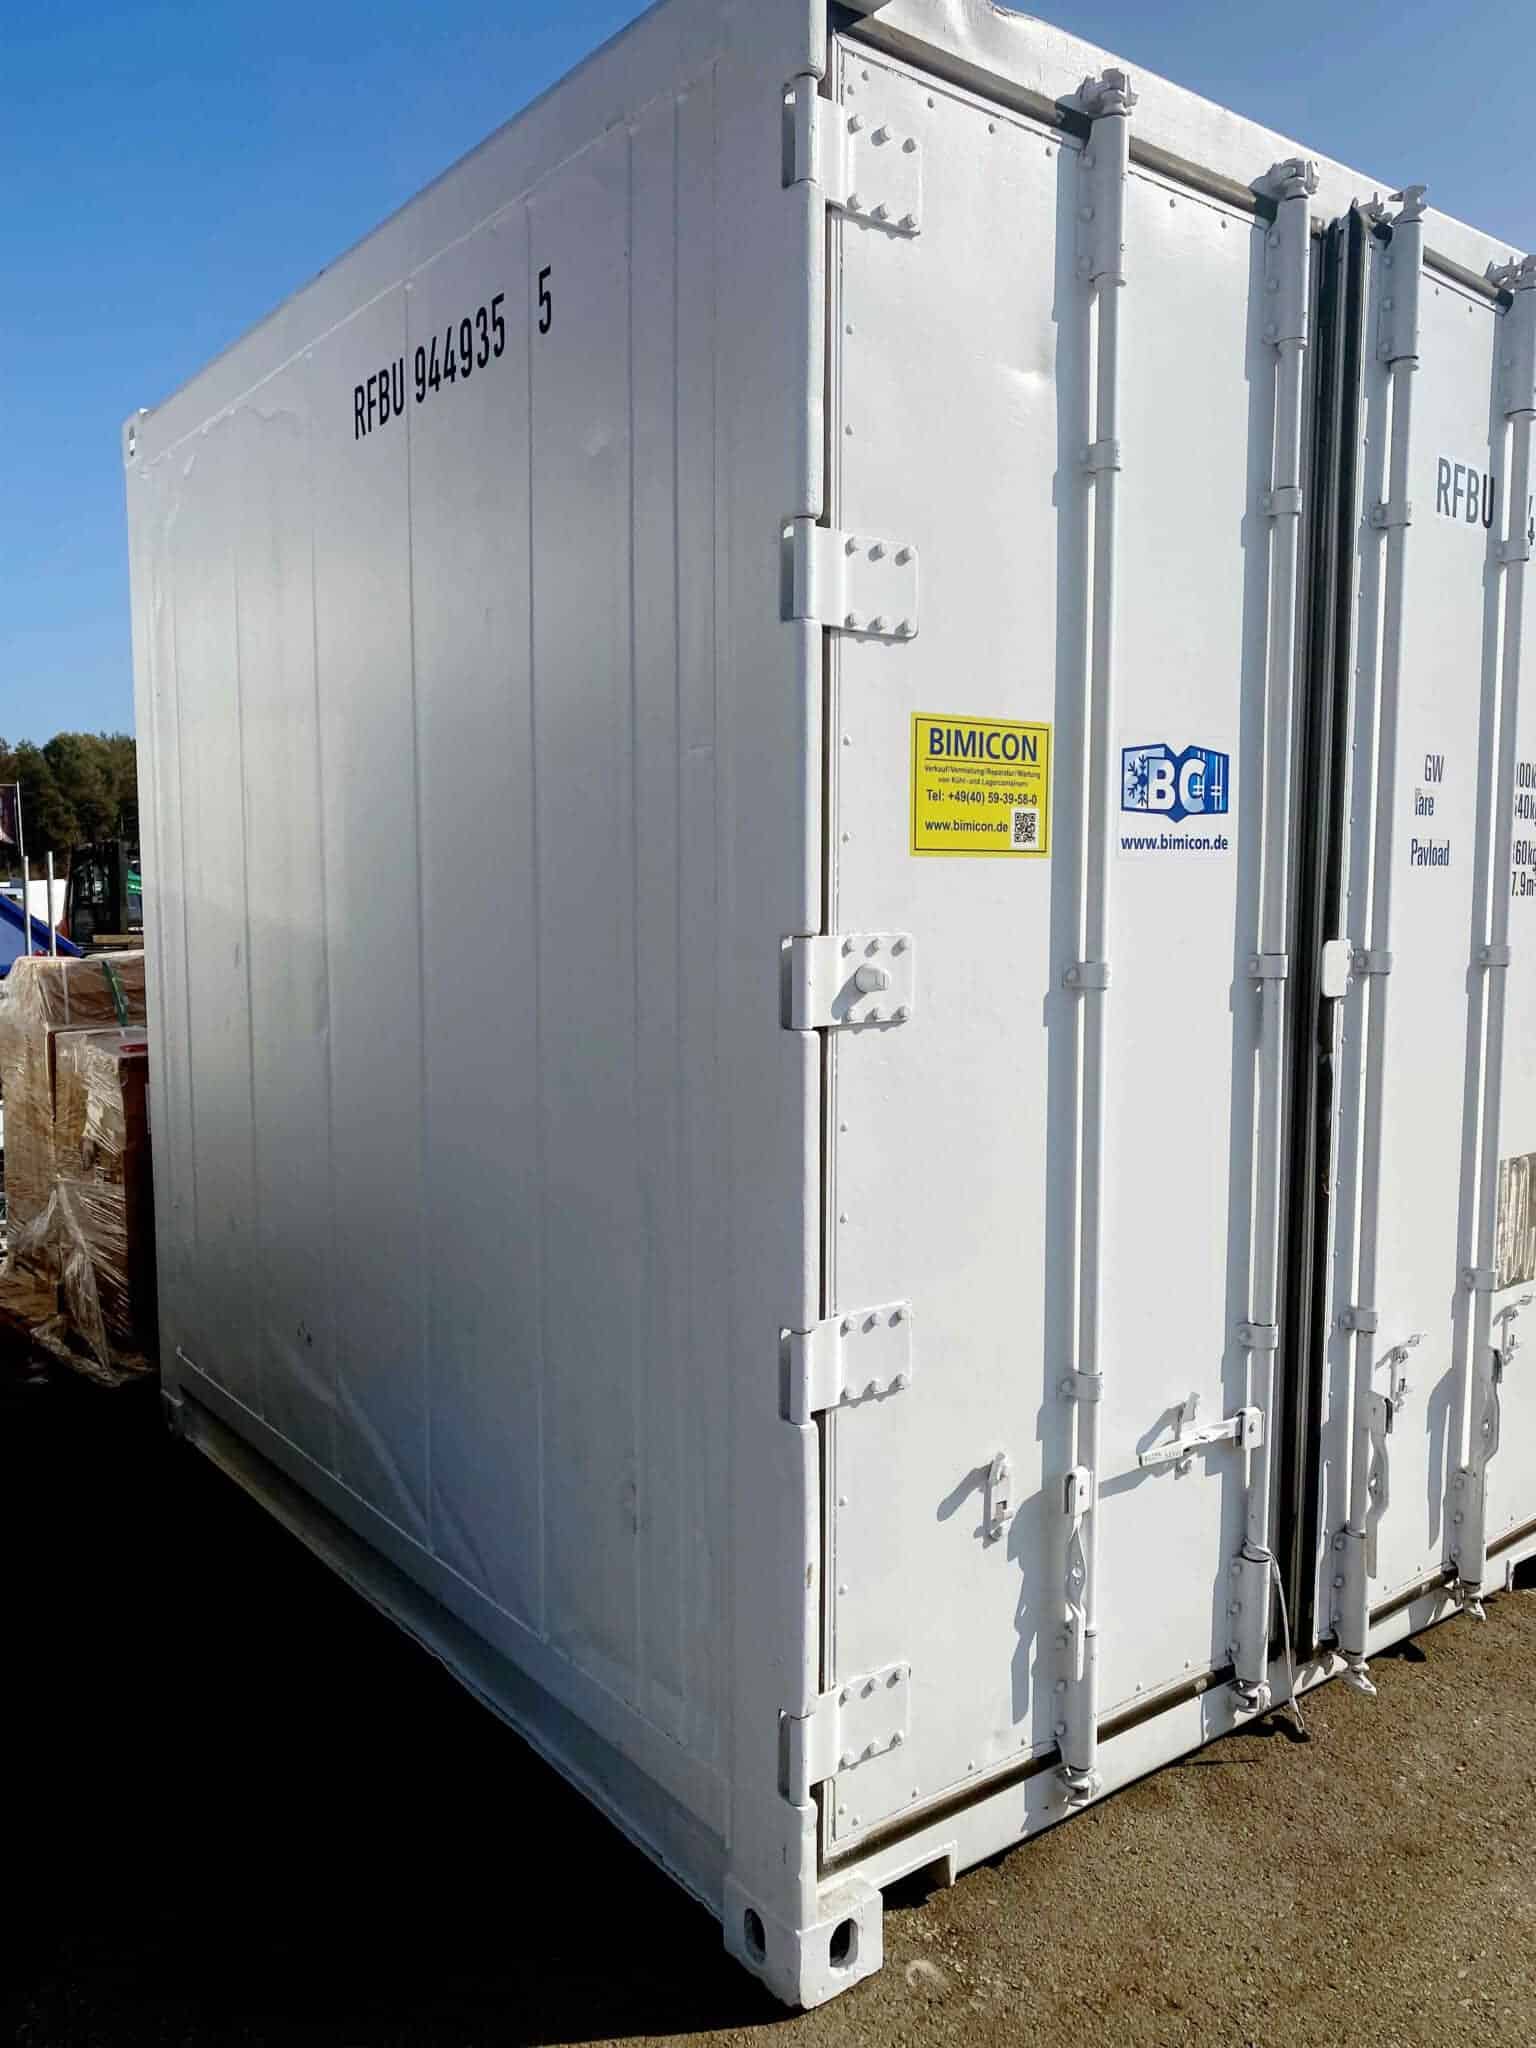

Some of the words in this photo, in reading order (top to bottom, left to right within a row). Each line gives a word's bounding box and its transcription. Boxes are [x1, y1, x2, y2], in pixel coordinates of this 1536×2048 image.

[354, 357, 405, 441] RFBU
[414, 292, 505, 404] 944935
[537, 264, 552, 335] 5
[1436, 456, 1495, 529] RFBU
[929, 727, 1038, 762] BIMICON
[1424, 753, 1445, 783] GW
[926, 789, 945, 801] Tel:
[947, 790, 986, 806] +49(40)
[987, 791, 1038, 806] 59-39-58-0
[925, 819, 1009, 833] www.bimicon.de
[1121, 833, 1229, 850] www.bimicon.de
